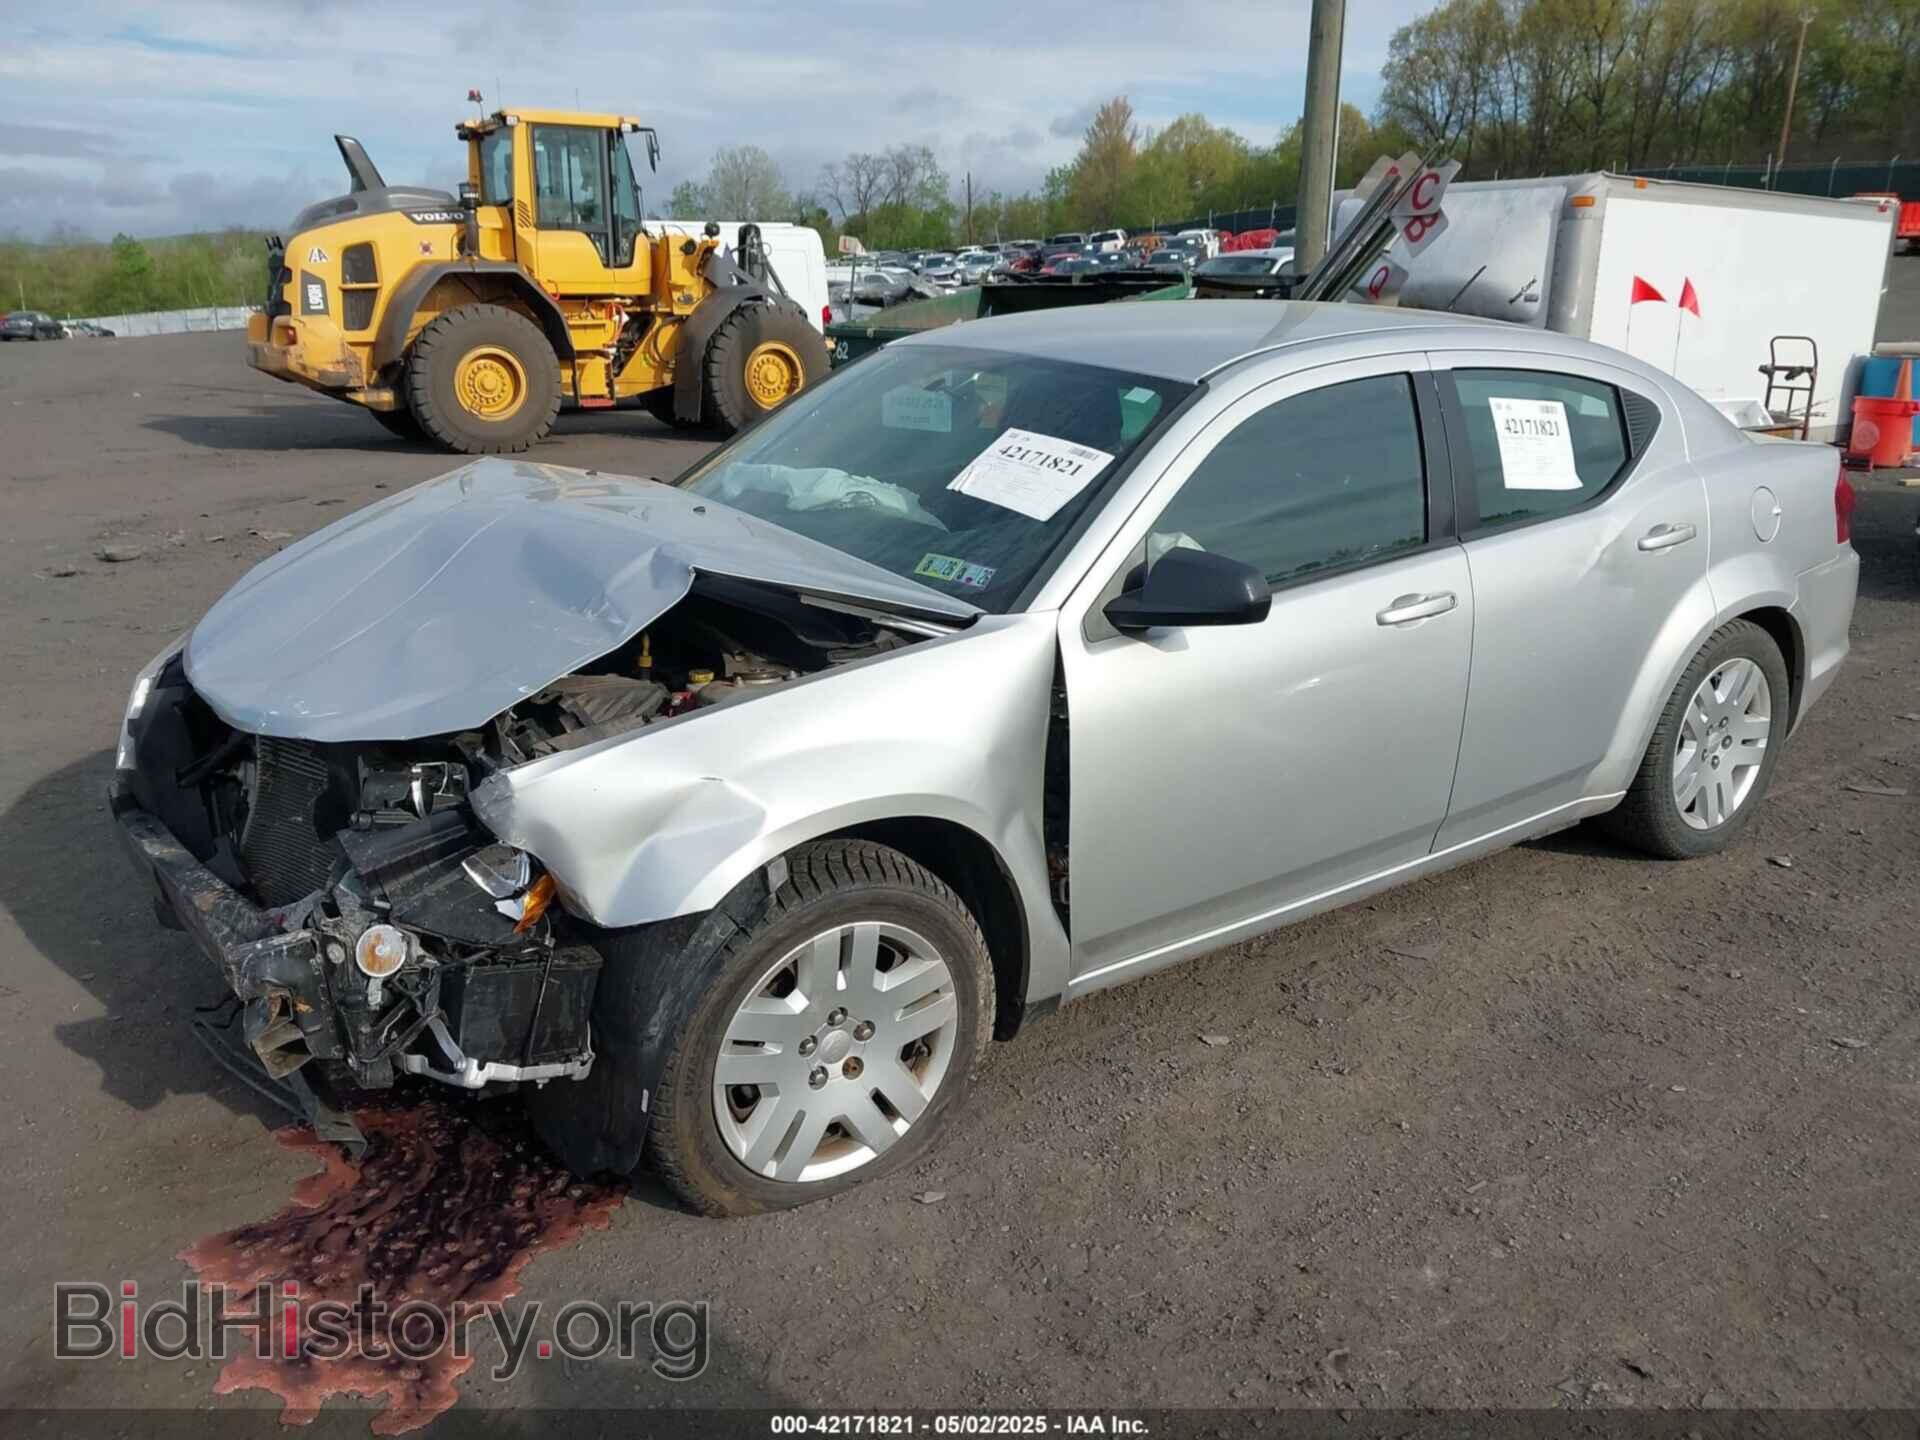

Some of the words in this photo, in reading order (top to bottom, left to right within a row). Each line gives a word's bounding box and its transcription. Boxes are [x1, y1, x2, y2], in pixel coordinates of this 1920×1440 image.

[1412, 172, 1441, 210] C
[411, 212, 465, 221] VOLVO
[1368, 265, 1390, 299] Q
[1504, 418, 1560, 437] 42171821
[998, 443, 1084, 477] 42171821
